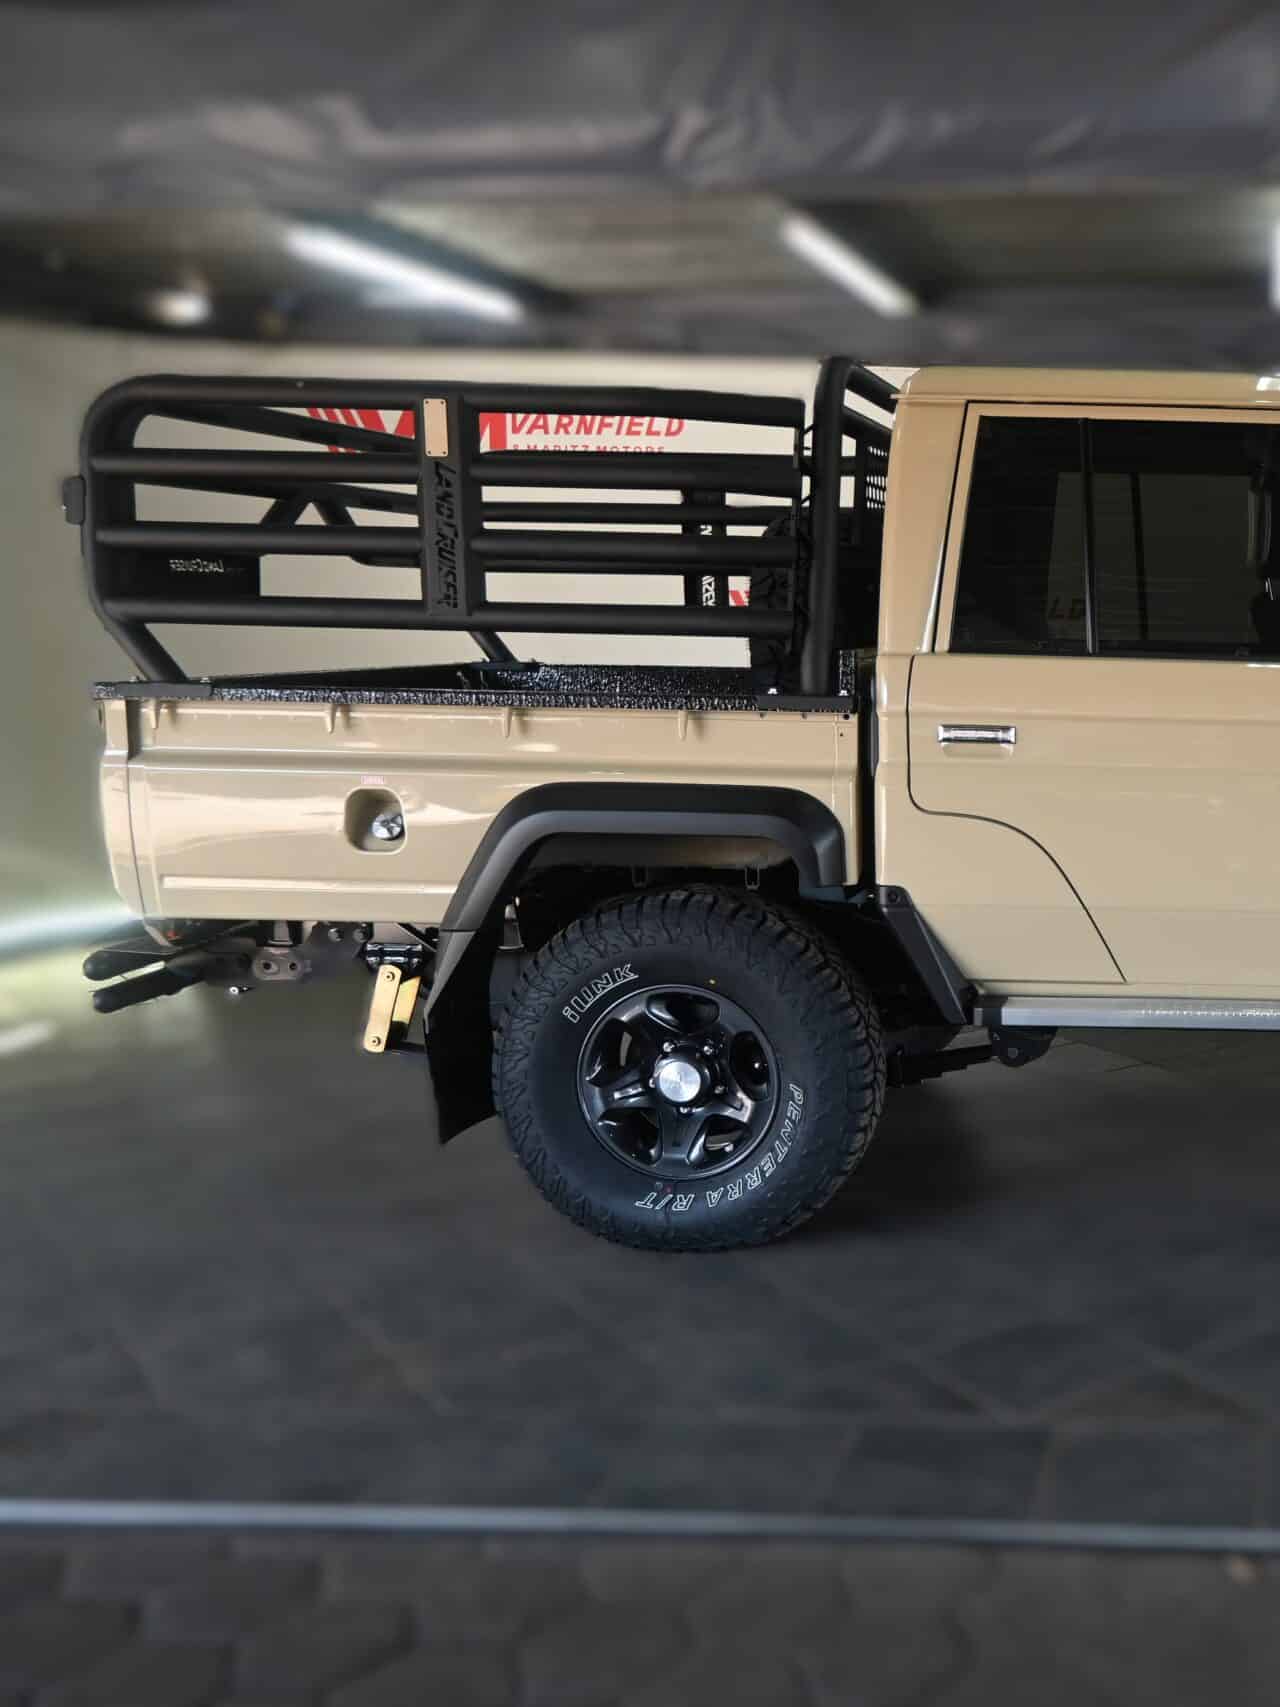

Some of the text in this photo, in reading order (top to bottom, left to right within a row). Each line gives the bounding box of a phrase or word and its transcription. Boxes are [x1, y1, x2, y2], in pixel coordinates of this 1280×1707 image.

[511, 413, 686, 437] VARNFIELD
[634, 1083, 804, 1211] PENTERRA R/T
